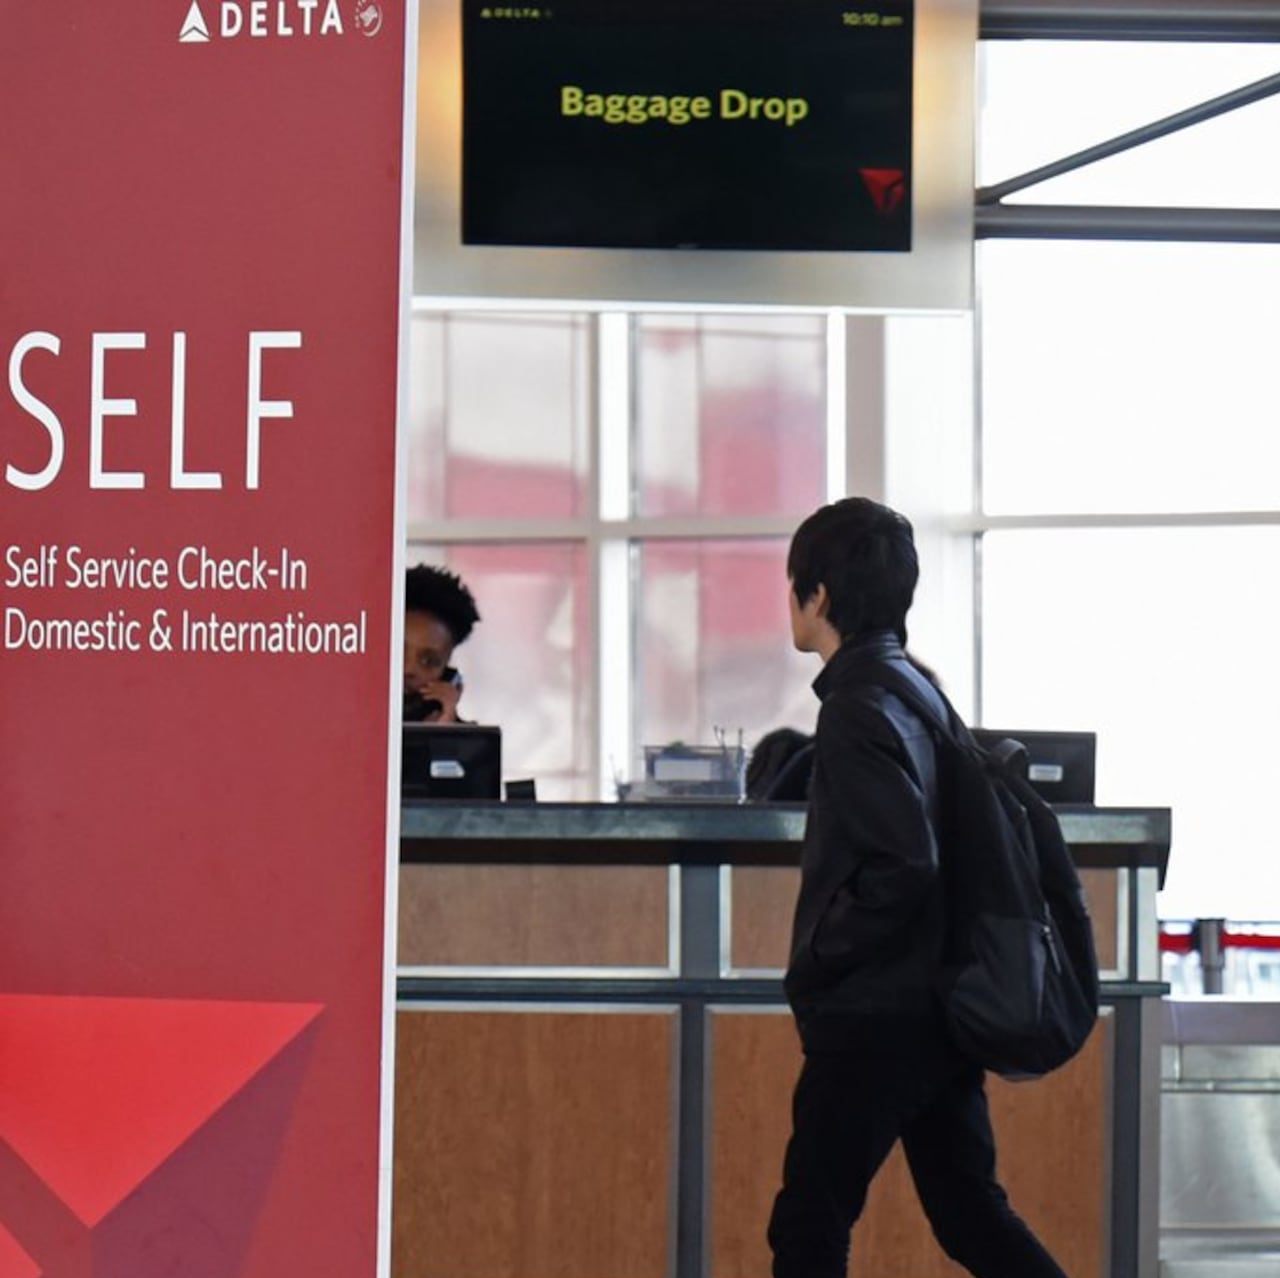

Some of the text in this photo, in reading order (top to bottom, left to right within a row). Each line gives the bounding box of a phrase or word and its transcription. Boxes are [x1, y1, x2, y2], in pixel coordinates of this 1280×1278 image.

[221, 0, 344, 37] DELTA
[561, 86, 809, 126] Baggage Drop
[5, 331, 302, 490] SELF
[5, 545, 308, 590] Self Service Check-In
[4, 608, 367, 654] Domestic & International
